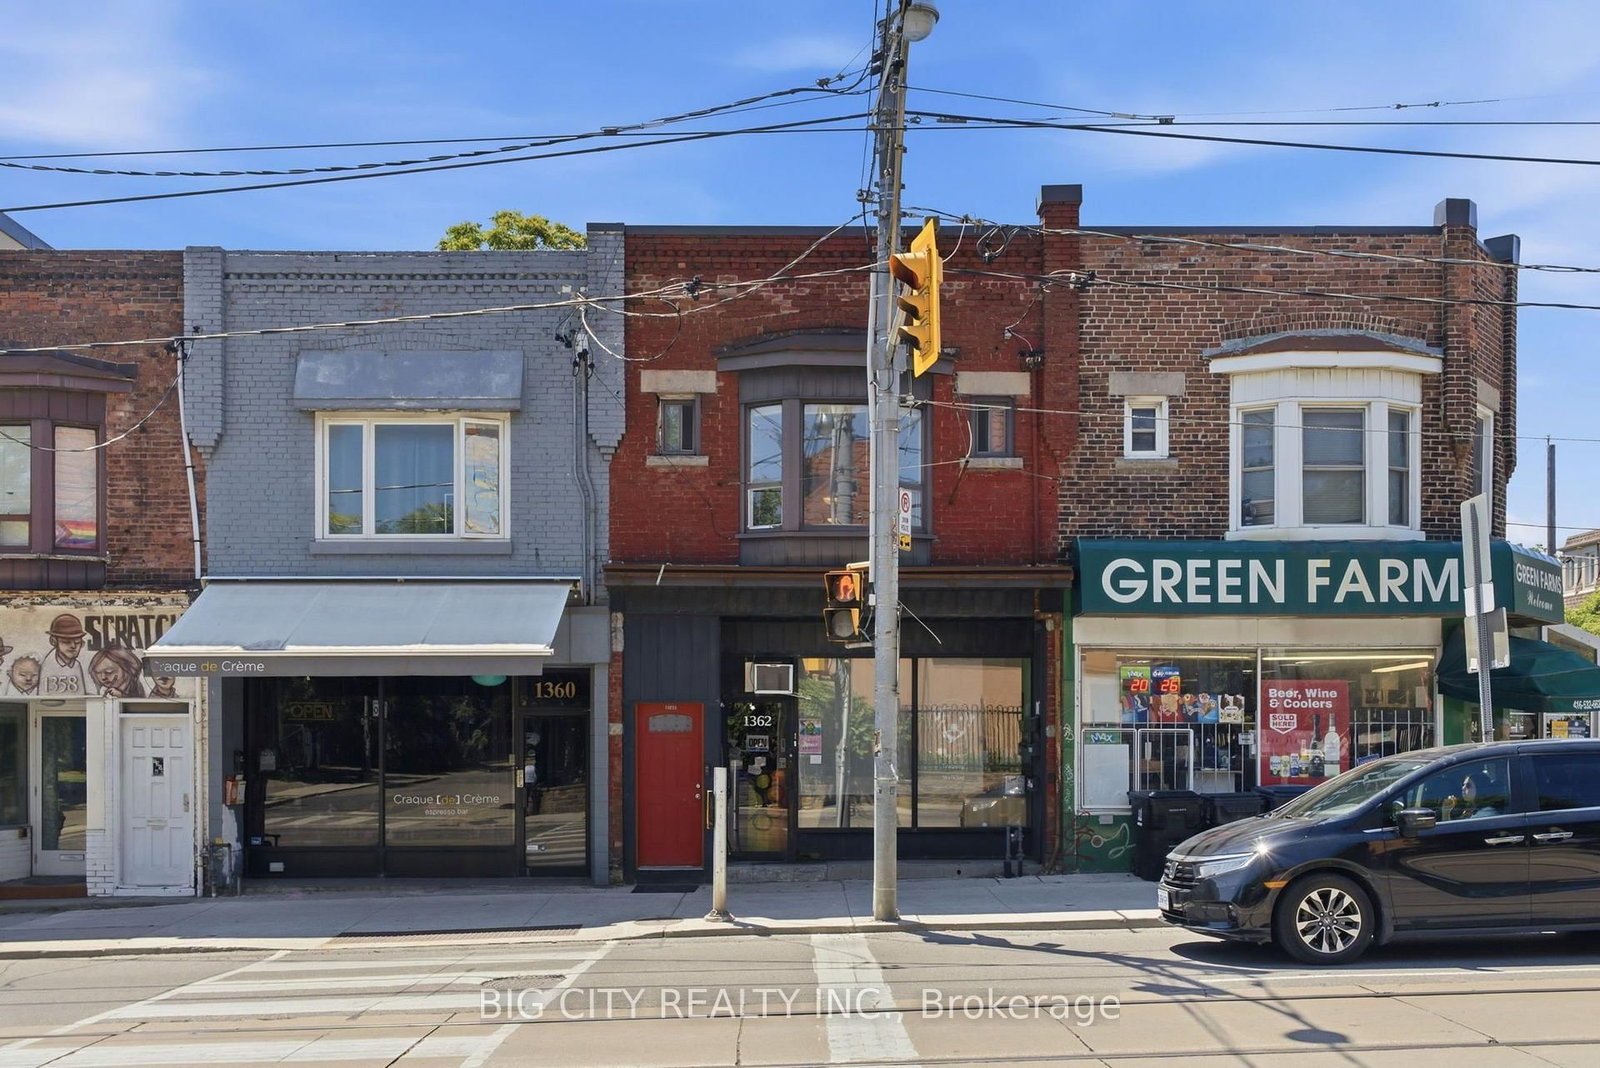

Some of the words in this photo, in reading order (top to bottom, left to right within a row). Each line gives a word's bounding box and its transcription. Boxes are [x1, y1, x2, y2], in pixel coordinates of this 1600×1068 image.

[1102, 558, 1284, 603] GREEN
[1308, 558, 1459, 603] FARM
[1515, 562, 1540, 588] GREEN
[1540, 570, 1562, 594] FARMS
[1527, 589, 1553, 611] Welcome
[84, 614, 184, 651] SCRATC
[201, 660, 218, 672] de
[221, 659, 265, 672] Crème
[535, 681, 577, 699] 1360
[1130, 679, 1149, 691] 20
[1160, 679, 1178, 692] 26
[1268, 688, 1302, 700] Beer,
[1305, 688, 1337, 698] Wine
[1283, 699, 1333, 709] Coolers
[290, 704, 332, 719] OPEN
[743, 715, 772, 727] 1362
[393, 794, 434, 806] Craque
[463, 793, 500, 804] Crème
[425, 808, 456, 816] espresso
